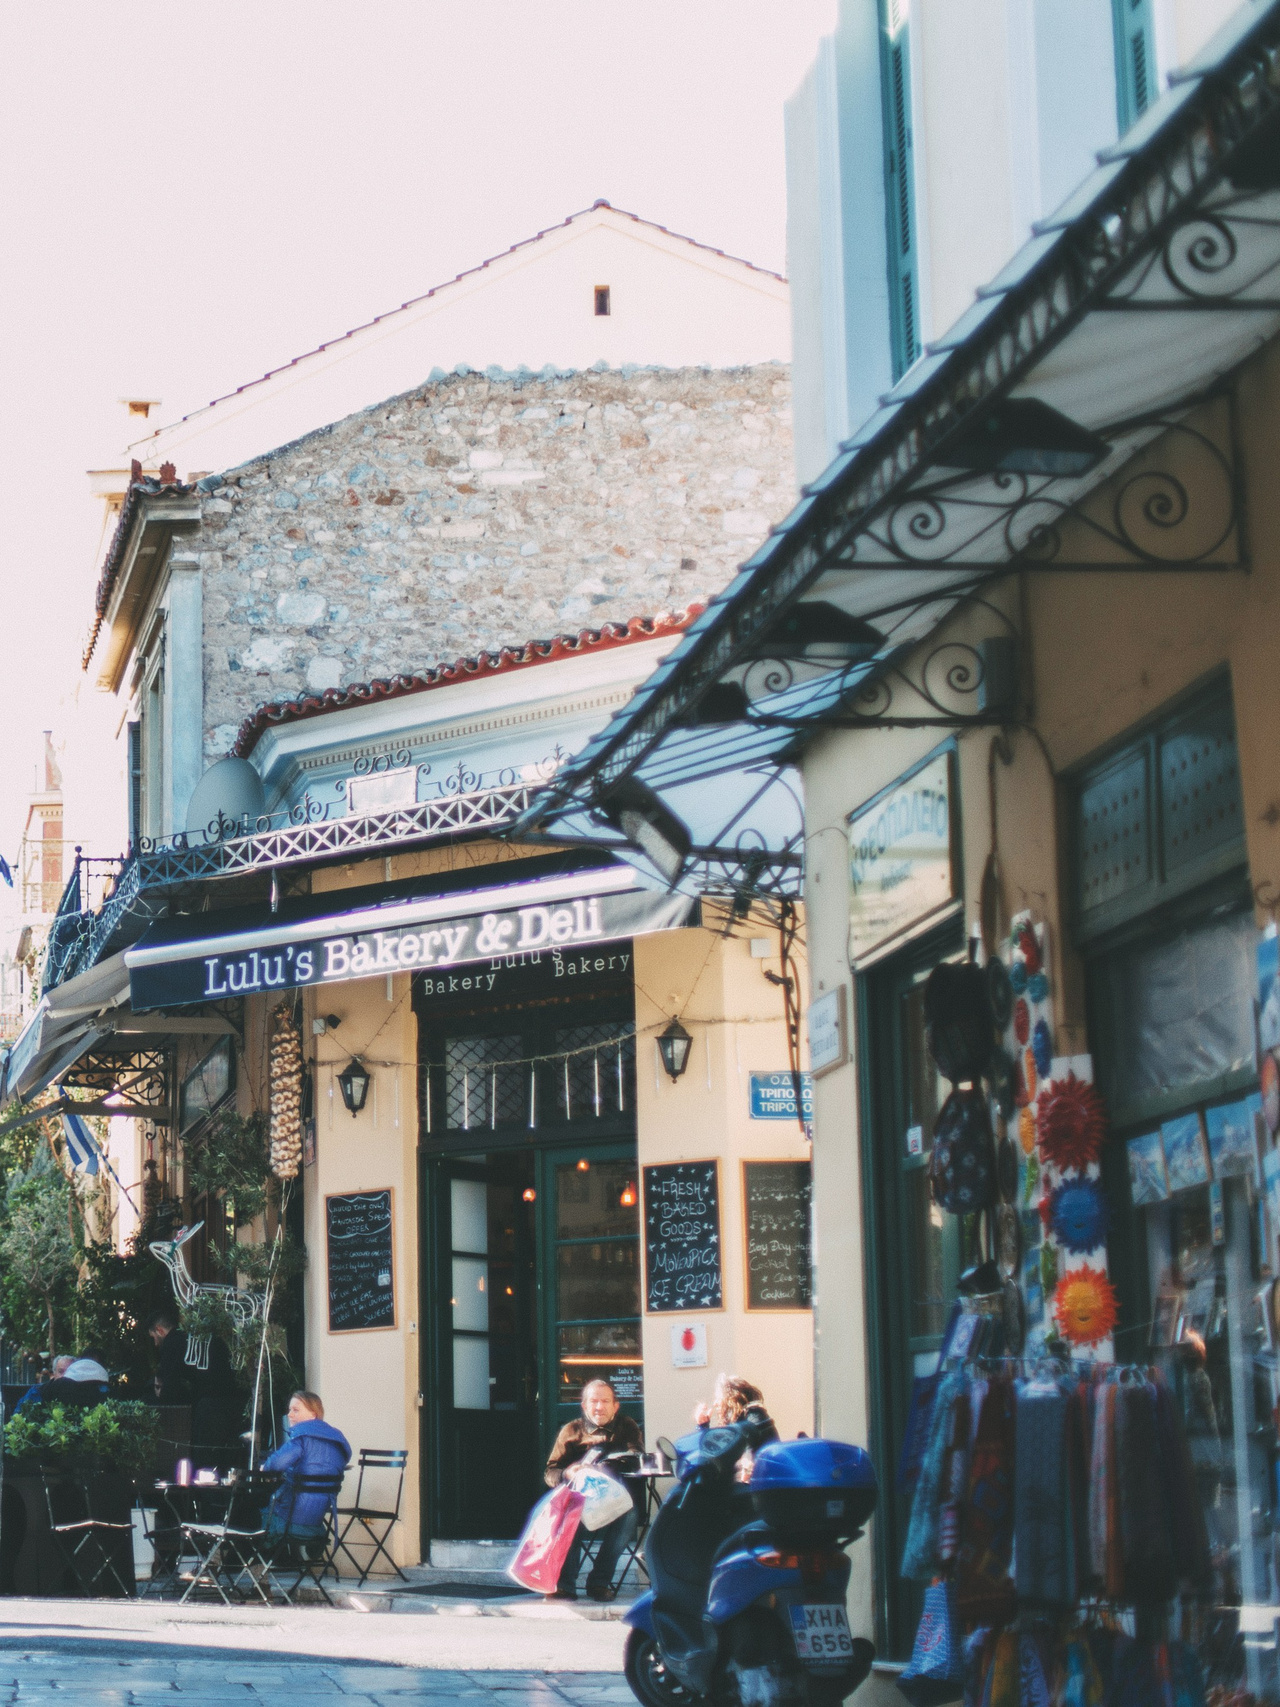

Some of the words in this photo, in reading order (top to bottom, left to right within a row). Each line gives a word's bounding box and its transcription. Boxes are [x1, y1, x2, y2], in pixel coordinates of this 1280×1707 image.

[204, 947, 313, 996] Lulu's
[323, 927, 472, 977] Bakery
[476, 914, 512, 953] &
[517, 898, 602, 949] Deli
[554, 954, 630, 977] Bakery
[424, 973, 496, 996] Bakery
[770, 1075, 812, 1085] ΟΔΣ
[759, 1088, 812, 1099] ΤΡΙΠΟΩ
[759, 1101, 812, 1113] TRIPOO
[662, 1176, 703, 1201] FRESH
[660, 1201, 707, 1219] BAKED
[660, 1220, 701, 1237] GOODS
[769, 1239, 792, 1257] Day
[649, 1278, 671, 1299] ICE
[675, 1272, 722, 1294] CREAM
[811, 1633, 851, 1653] 656
